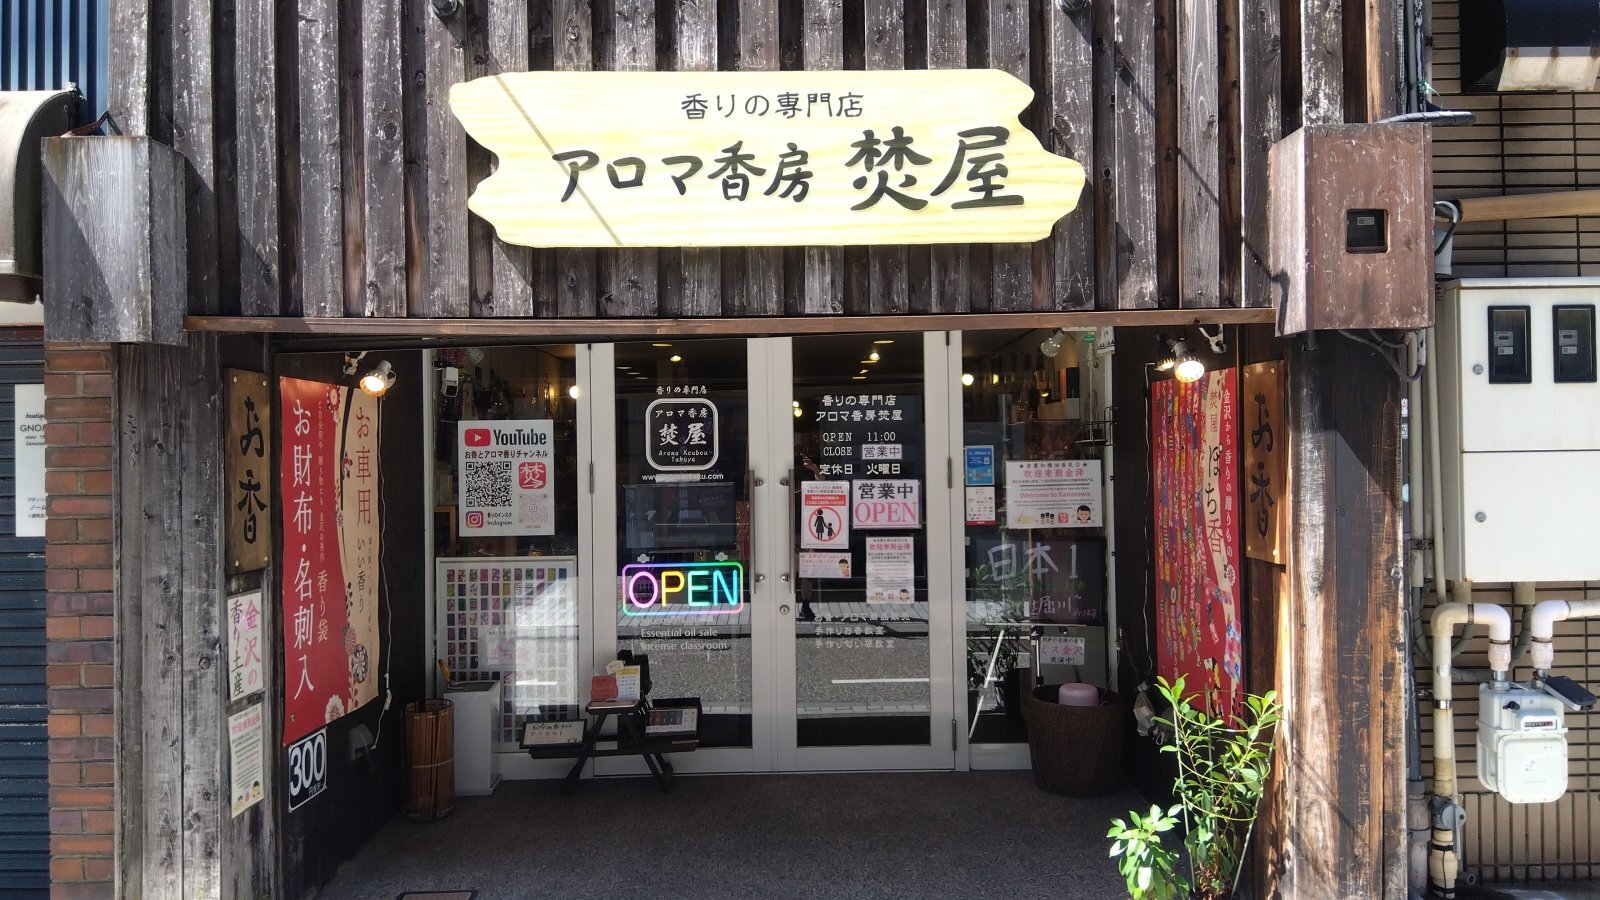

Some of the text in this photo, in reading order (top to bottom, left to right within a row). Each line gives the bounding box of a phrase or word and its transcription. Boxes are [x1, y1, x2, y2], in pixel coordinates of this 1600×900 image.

[681, 92, 865, 120] 香りの専門店
[551, 125, 1026, 212] アロマ香房 焚屋
[655, 385, 708, 395] 香りの専門店
[821, 394, 897, 406] 香りの専門店
[654, 407, 709, 418] アロマ香房
[815, 409, 903, 421] アロマ香房焚屋
[493, 429, 547, 446] YouTube
[658, 422, 707, 446] 焚屋
[822, 432, 896, 441] OPEN 11:00
[464, 450, 548, 459] お香とアロマ香りチャンネル
[823, 447, 853, 456] CLOSE
[863, 446, 900, 457] 営業中
[236, 396, 268, 545] お香
[355, 406, 372, 526] お車用
[820, 463, 901, 475] 定休日 火曜日
[1222, 388, 1234, 558] 金沢から香りの贈りもの
[1250, 391, 1276, 539] お香
[858, 483, 914, 500] 営業中
[1058, 490, 1091, 498] Kanazawa
[1204, 443, 1225, 557] ぽち香
[855, 502, 917, 523] OPEN
[292, 398, 316, 701] お財布・名刺入
[629, 570, 738, 608] OPEN
[316, 569, 329, 643] 香り袋
[243, 599, 262, 686] 金沢の
[641, 627, 718, 638] Essential oil sale
[230, 600, 245, 698] 香り土産
[680, 639, 728, 651] classroom
[289, 734, 326, 797] 300
